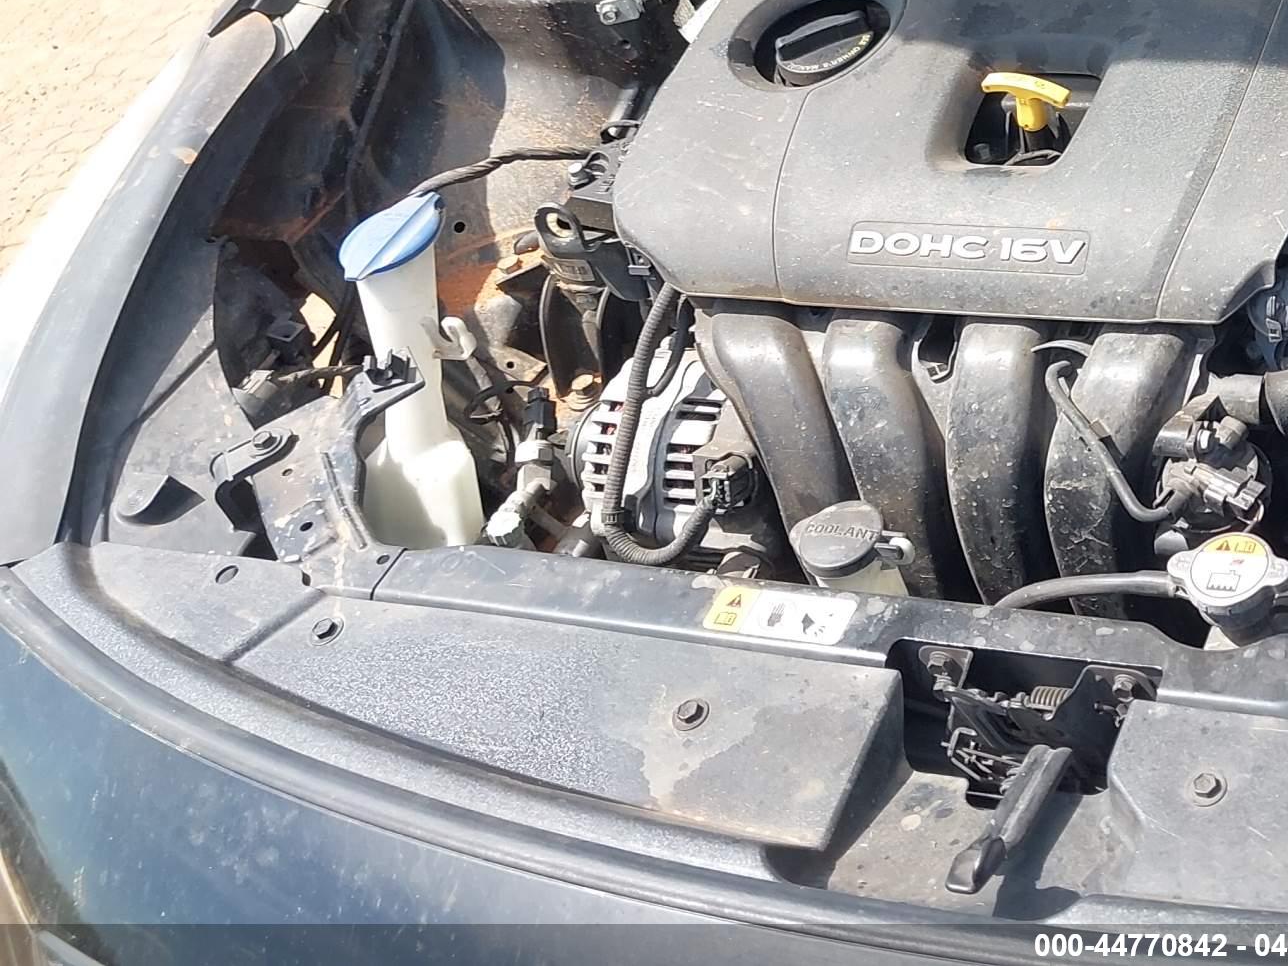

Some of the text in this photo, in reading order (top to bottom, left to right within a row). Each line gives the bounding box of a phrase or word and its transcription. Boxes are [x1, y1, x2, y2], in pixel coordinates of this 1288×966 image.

[849, 230, 1087, 264] DOHC 16V
[806, 523, 880, 541] COOLANT
